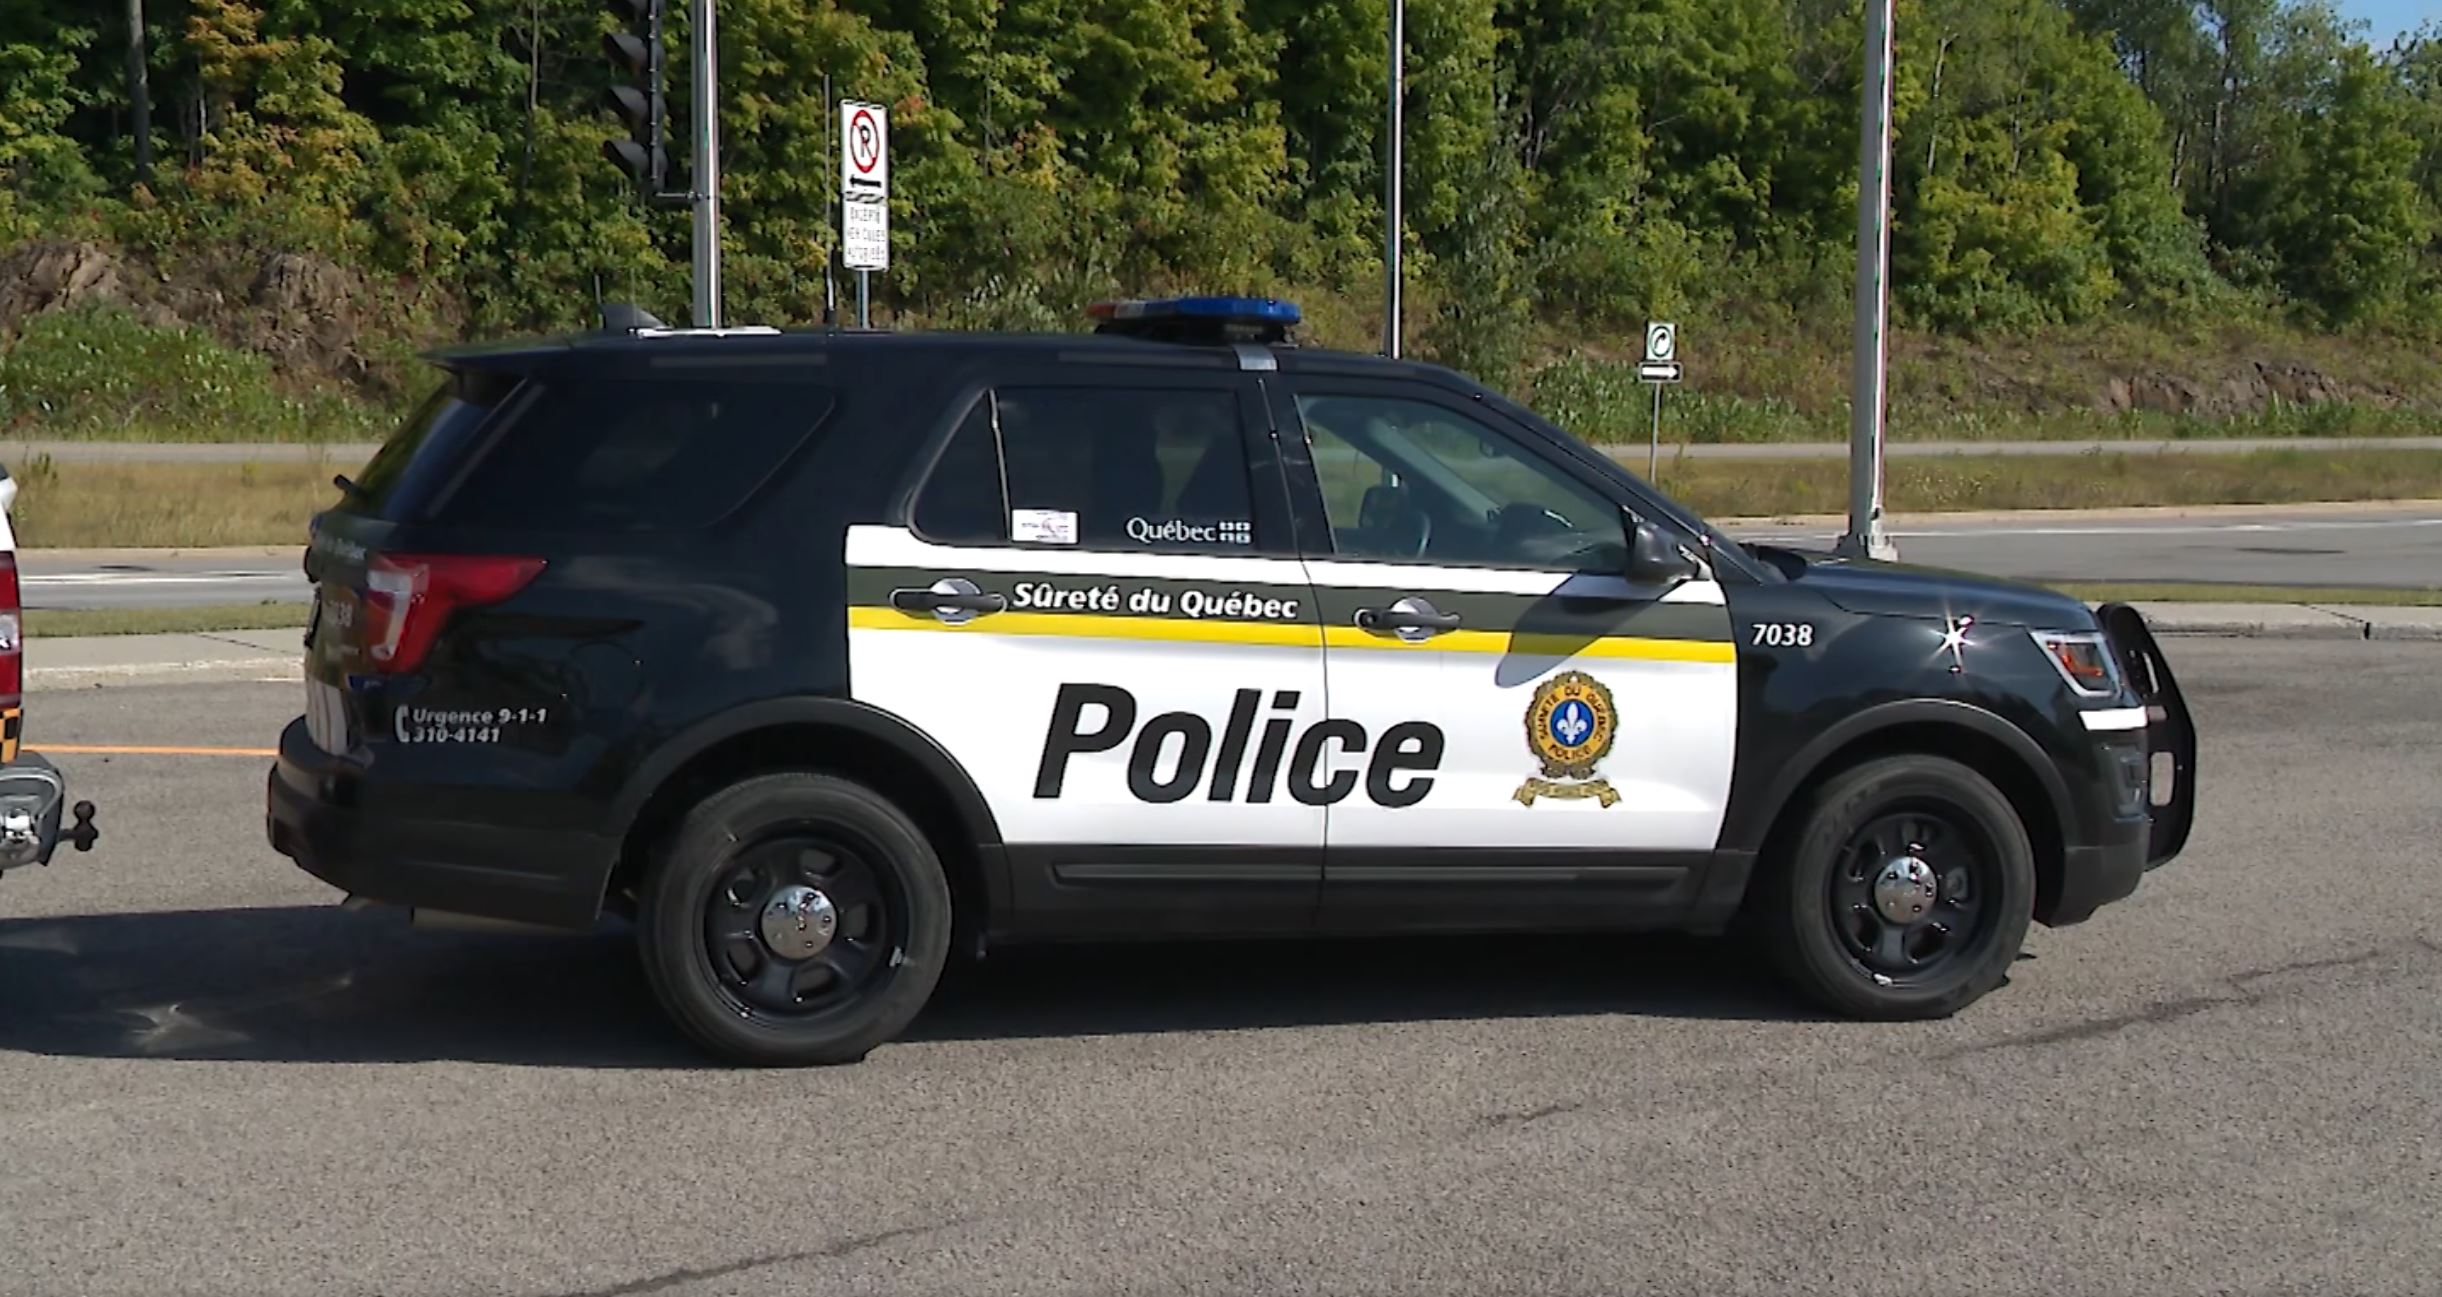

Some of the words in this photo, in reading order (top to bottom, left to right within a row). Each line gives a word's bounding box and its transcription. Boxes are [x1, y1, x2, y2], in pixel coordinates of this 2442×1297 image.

[1126, 516, 1217, 543] Québec
[1013, 582, 1120, 611] Sûreté
[1129, 588, 1171, 613] du
[1180, 590, 1299, 619] Québec
[1752, 623, 1813, 646] 7038
[413, 707, 494, 727] Urgence
[499, 708, 548, 725] 9-1-1
[413, 727, 501, 743] 310-4141
[1032, 683, 1446, 809] Police
